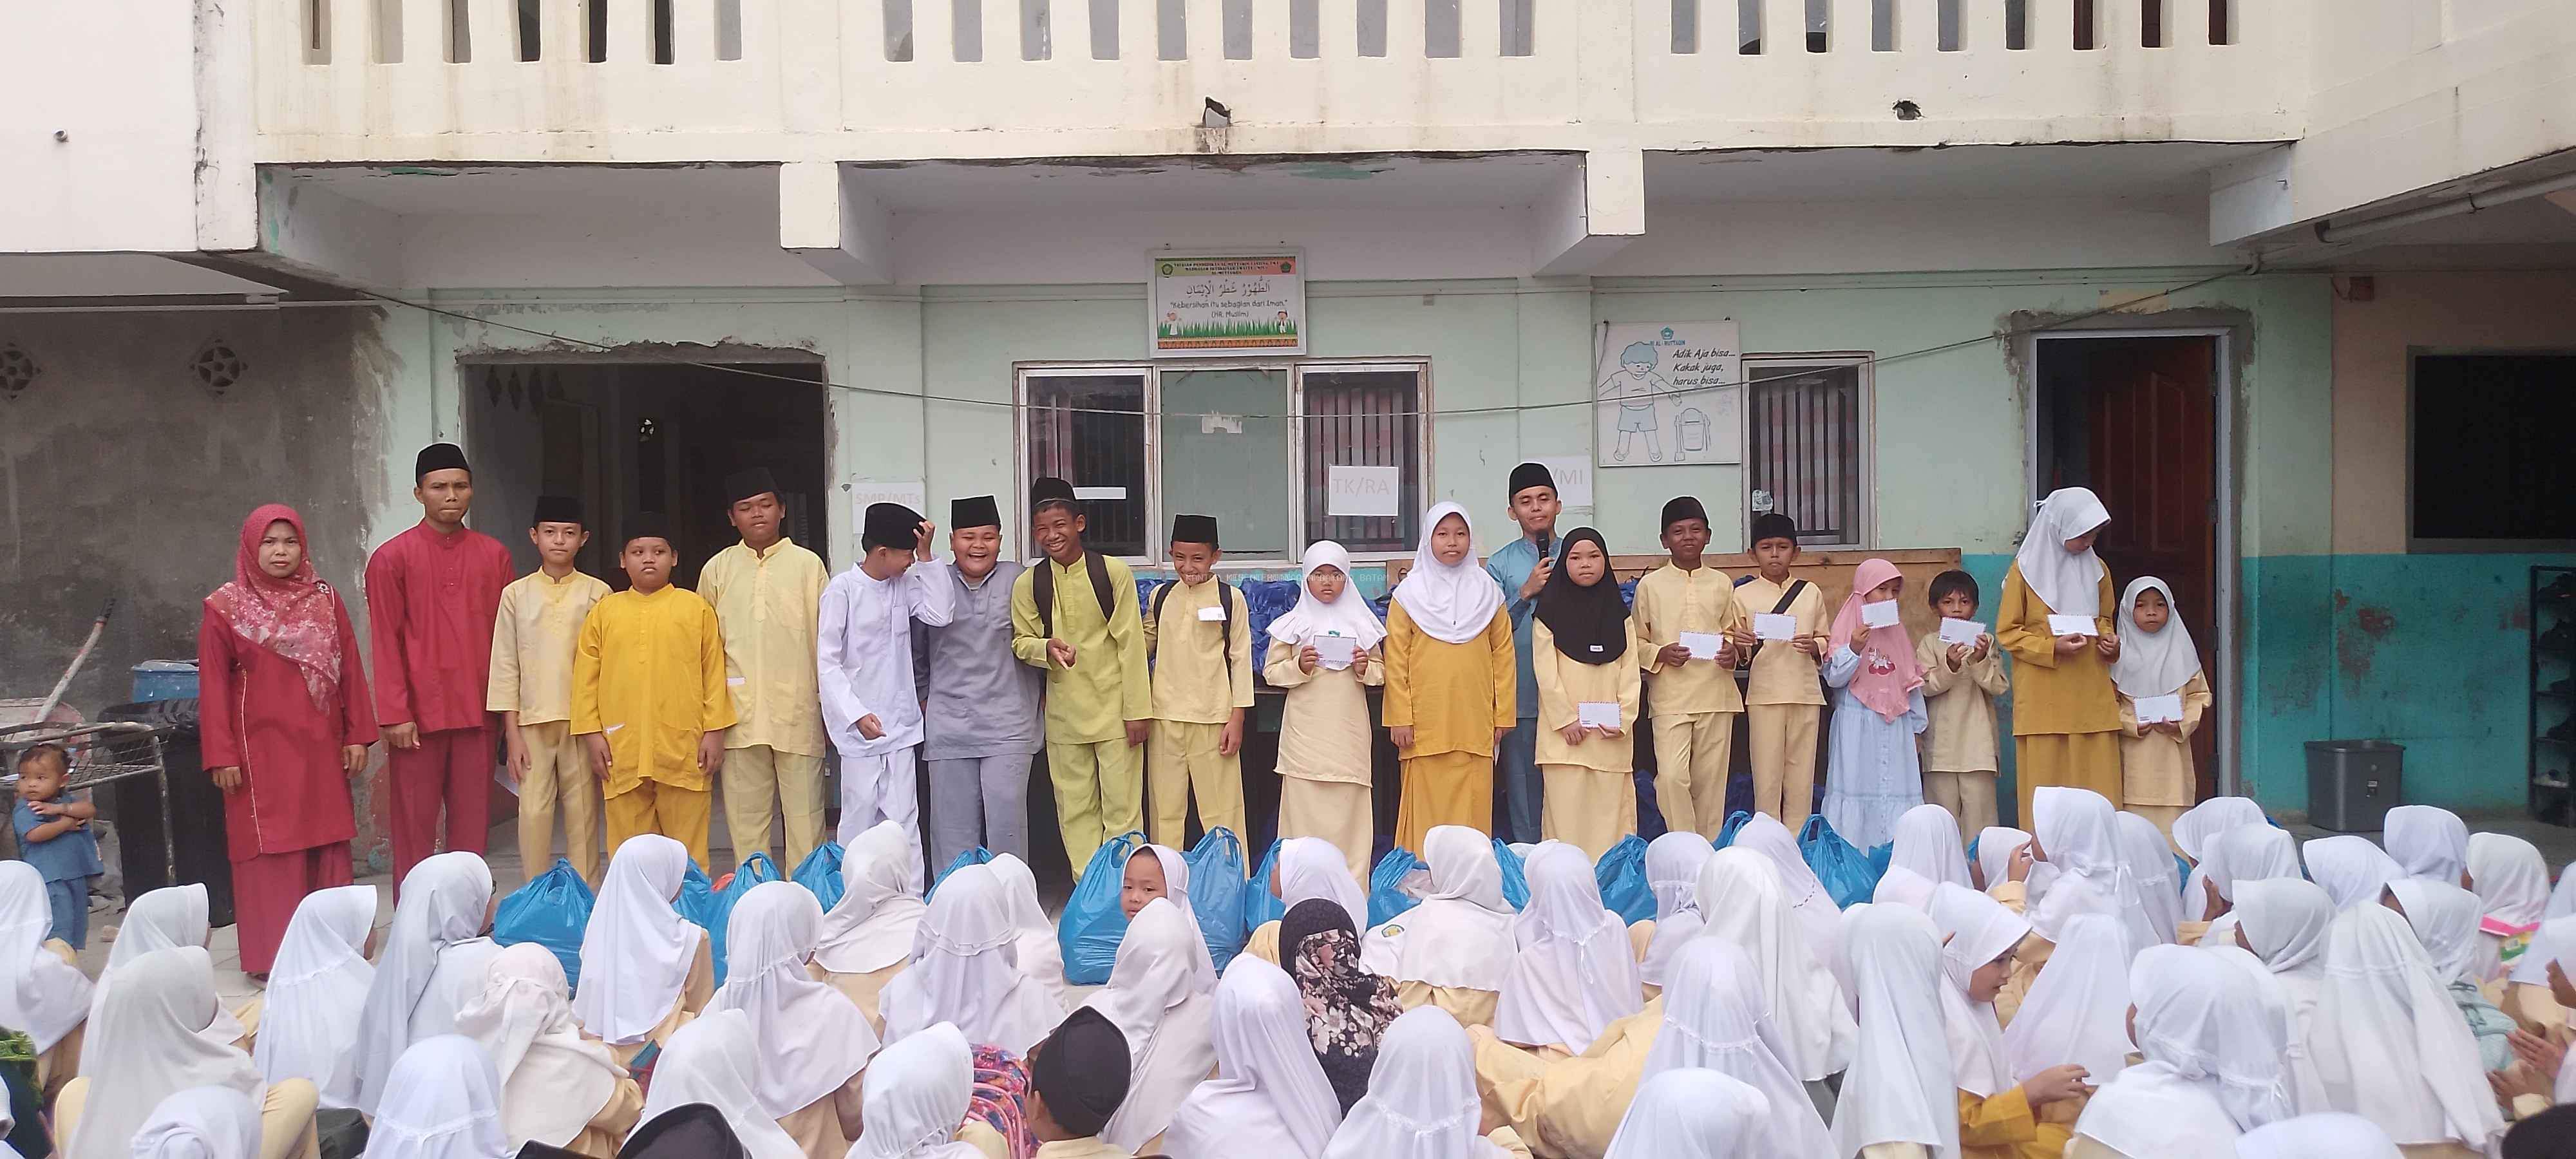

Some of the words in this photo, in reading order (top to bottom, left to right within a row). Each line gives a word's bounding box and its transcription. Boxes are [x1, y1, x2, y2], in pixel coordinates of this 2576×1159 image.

[1672, 348, 1692, 358] Adik
[1694, 348, 1710, 359] Aja
[1673, 362, 1700, 372] Kakak
[1700, 363, 1724, 373] juga,
[1673, 376, 1698, 385] harus
[1333, 477, 1390, 498] TK/RA
